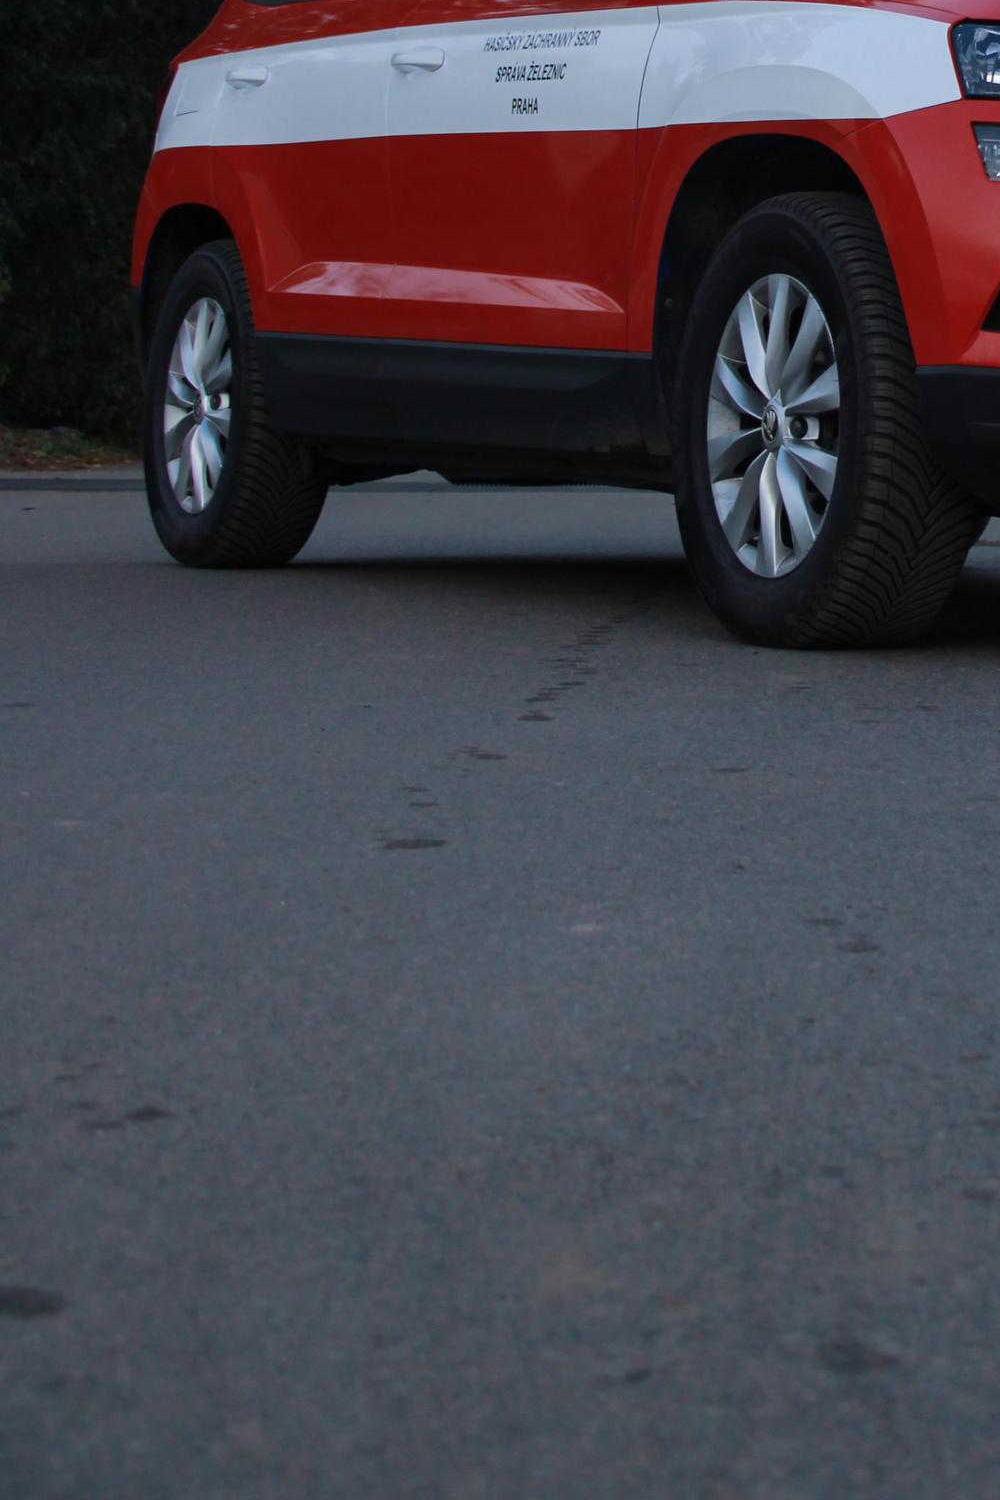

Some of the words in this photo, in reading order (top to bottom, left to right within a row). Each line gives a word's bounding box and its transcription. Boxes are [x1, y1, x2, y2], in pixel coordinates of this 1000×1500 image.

[574, 30, 601, 47] SBOR
[495, 63, 526, 82] SPRÁVA
[526, 61, 567, 81] ŽELEZNIC
[511, 98, 539, 115] PRAHA
